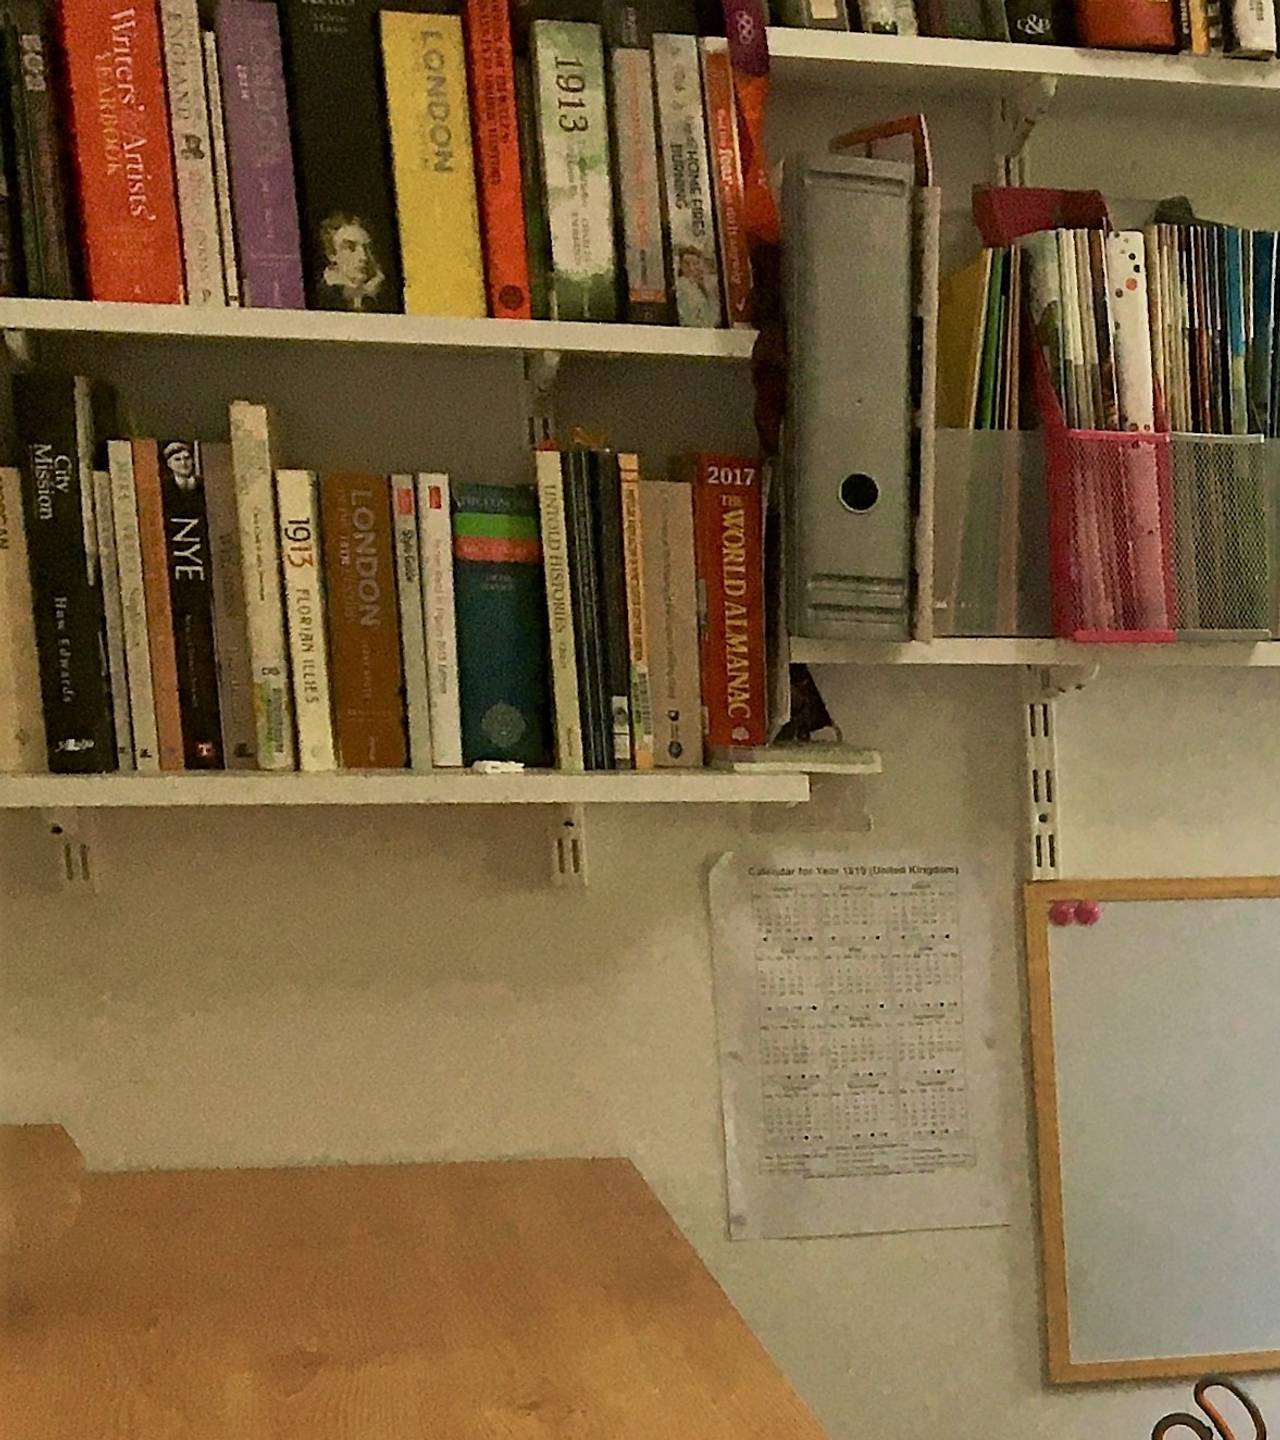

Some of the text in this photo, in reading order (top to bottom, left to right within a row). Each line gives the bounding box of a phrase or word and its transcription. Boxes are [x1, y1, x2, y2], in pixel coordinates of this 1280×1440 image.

[168, 11, 190, 121] ENGLAND
[420, 29, 454, 174] LONDON
[555, 54, 589, 133] 1913
[95, 50, 121, 177] YEARBOOK
[109, 7, 157, 223] Writers' Artists'
[669, 143, 688, 210] BURNING
[685, 150, 701, 194] HOME
[718, 147, 735, 186] fear
[691, 196, 705, 238] FIRES
[33, 443, 54, 520] Mission
[54, 453, 73, 494] City
[706, 465, 757, 487] 2017
[168, 516, 207, 582] NYE
[283, 516, 312, 571] 1913
[350, 488, 382, 627] LONDON
[545, 483, 570, 634] UNTOLD HISTORIES
[719, 507, 746, 601] WORLD
[52, 595, 75, 704] Huw Edwards
[293, 588, 320, 705] FLORIAN ILLIES
[723, 601, 752, 720] ALMANAC
[748, 866, 795, 876] Calendar
